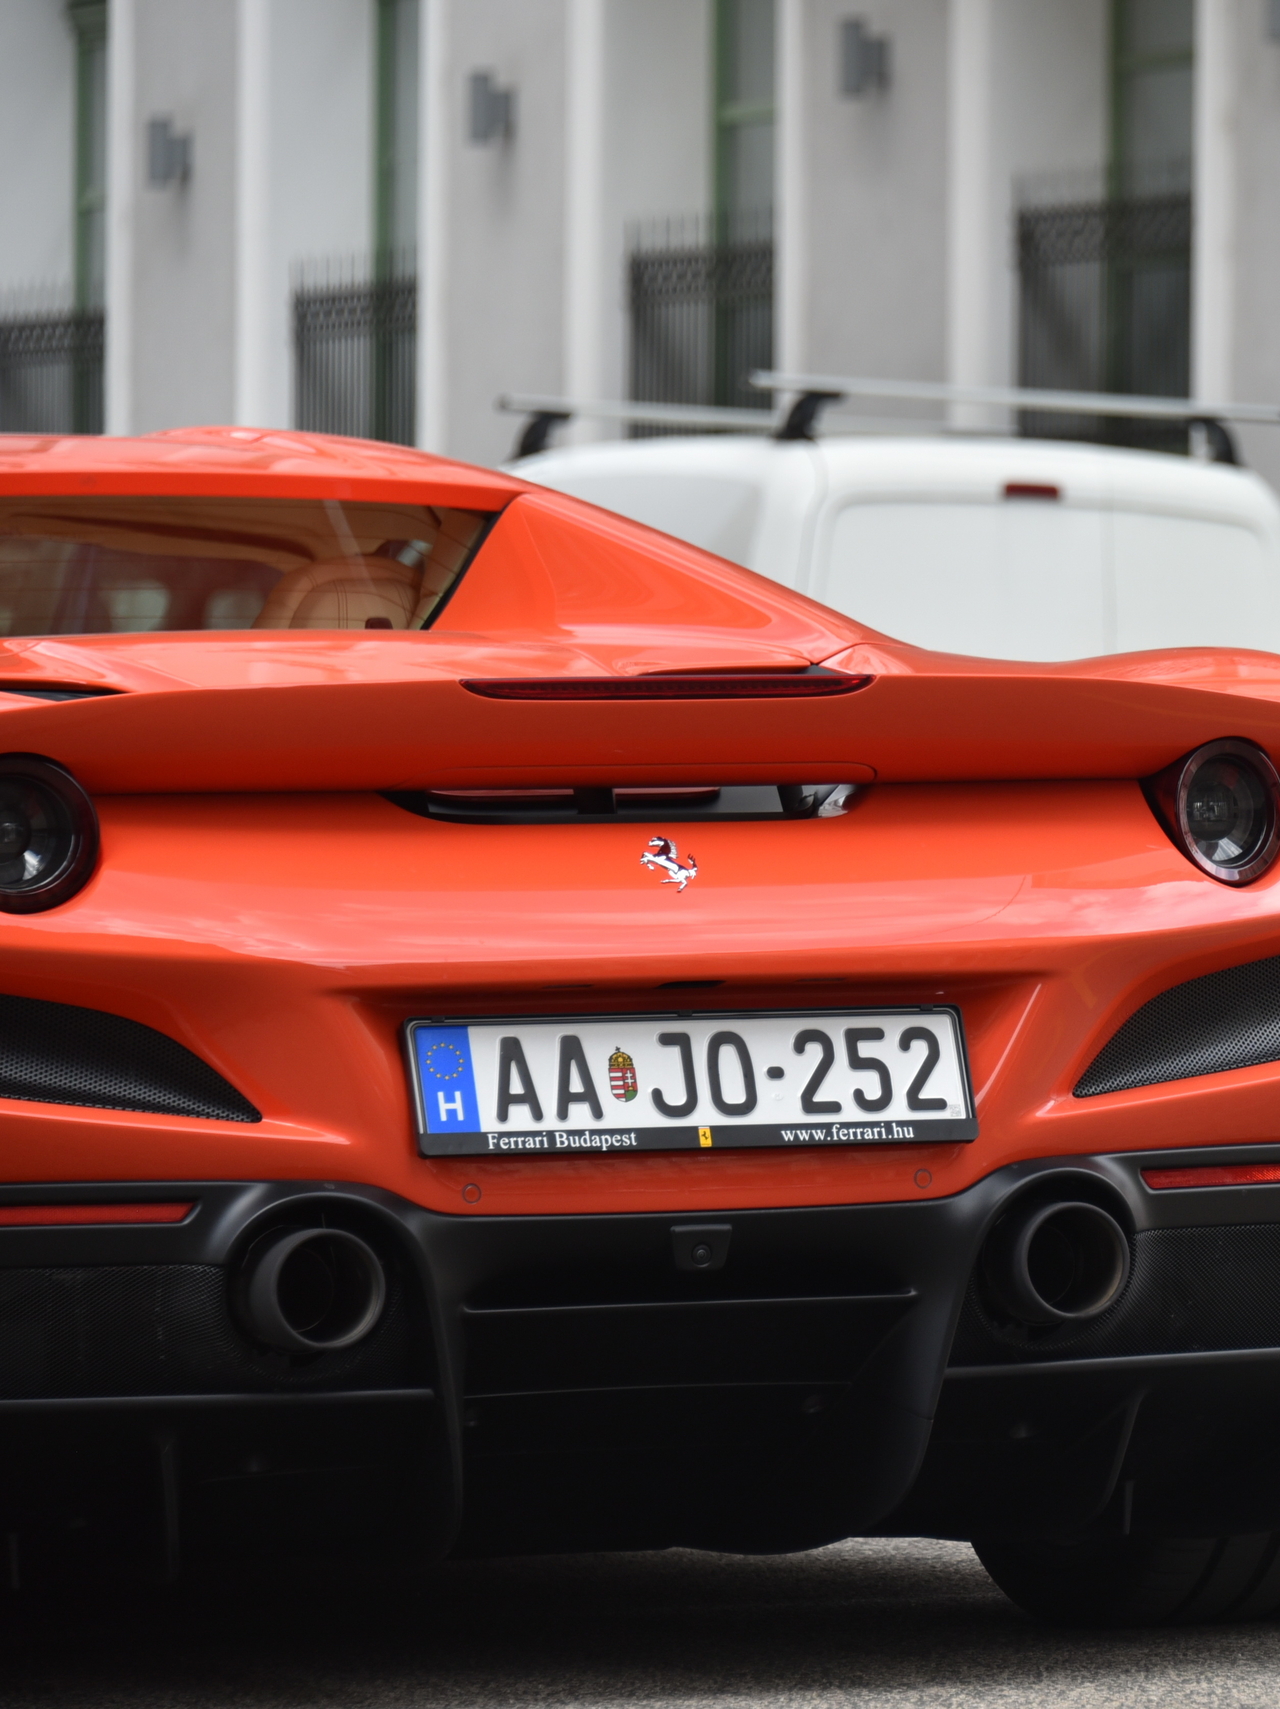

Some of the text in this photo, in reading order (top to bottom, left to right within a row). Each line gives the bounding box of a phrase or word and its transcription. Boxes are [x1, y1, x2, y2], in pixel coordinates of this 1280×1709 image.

[497, 1026, 948, 1123] AA JO-252
[437, 1091, 464, 1122] H
[486, 1130, 638, 1151] Ferrari Budapest
[780, 1123, 915, 1142] www.ferrari.hu
